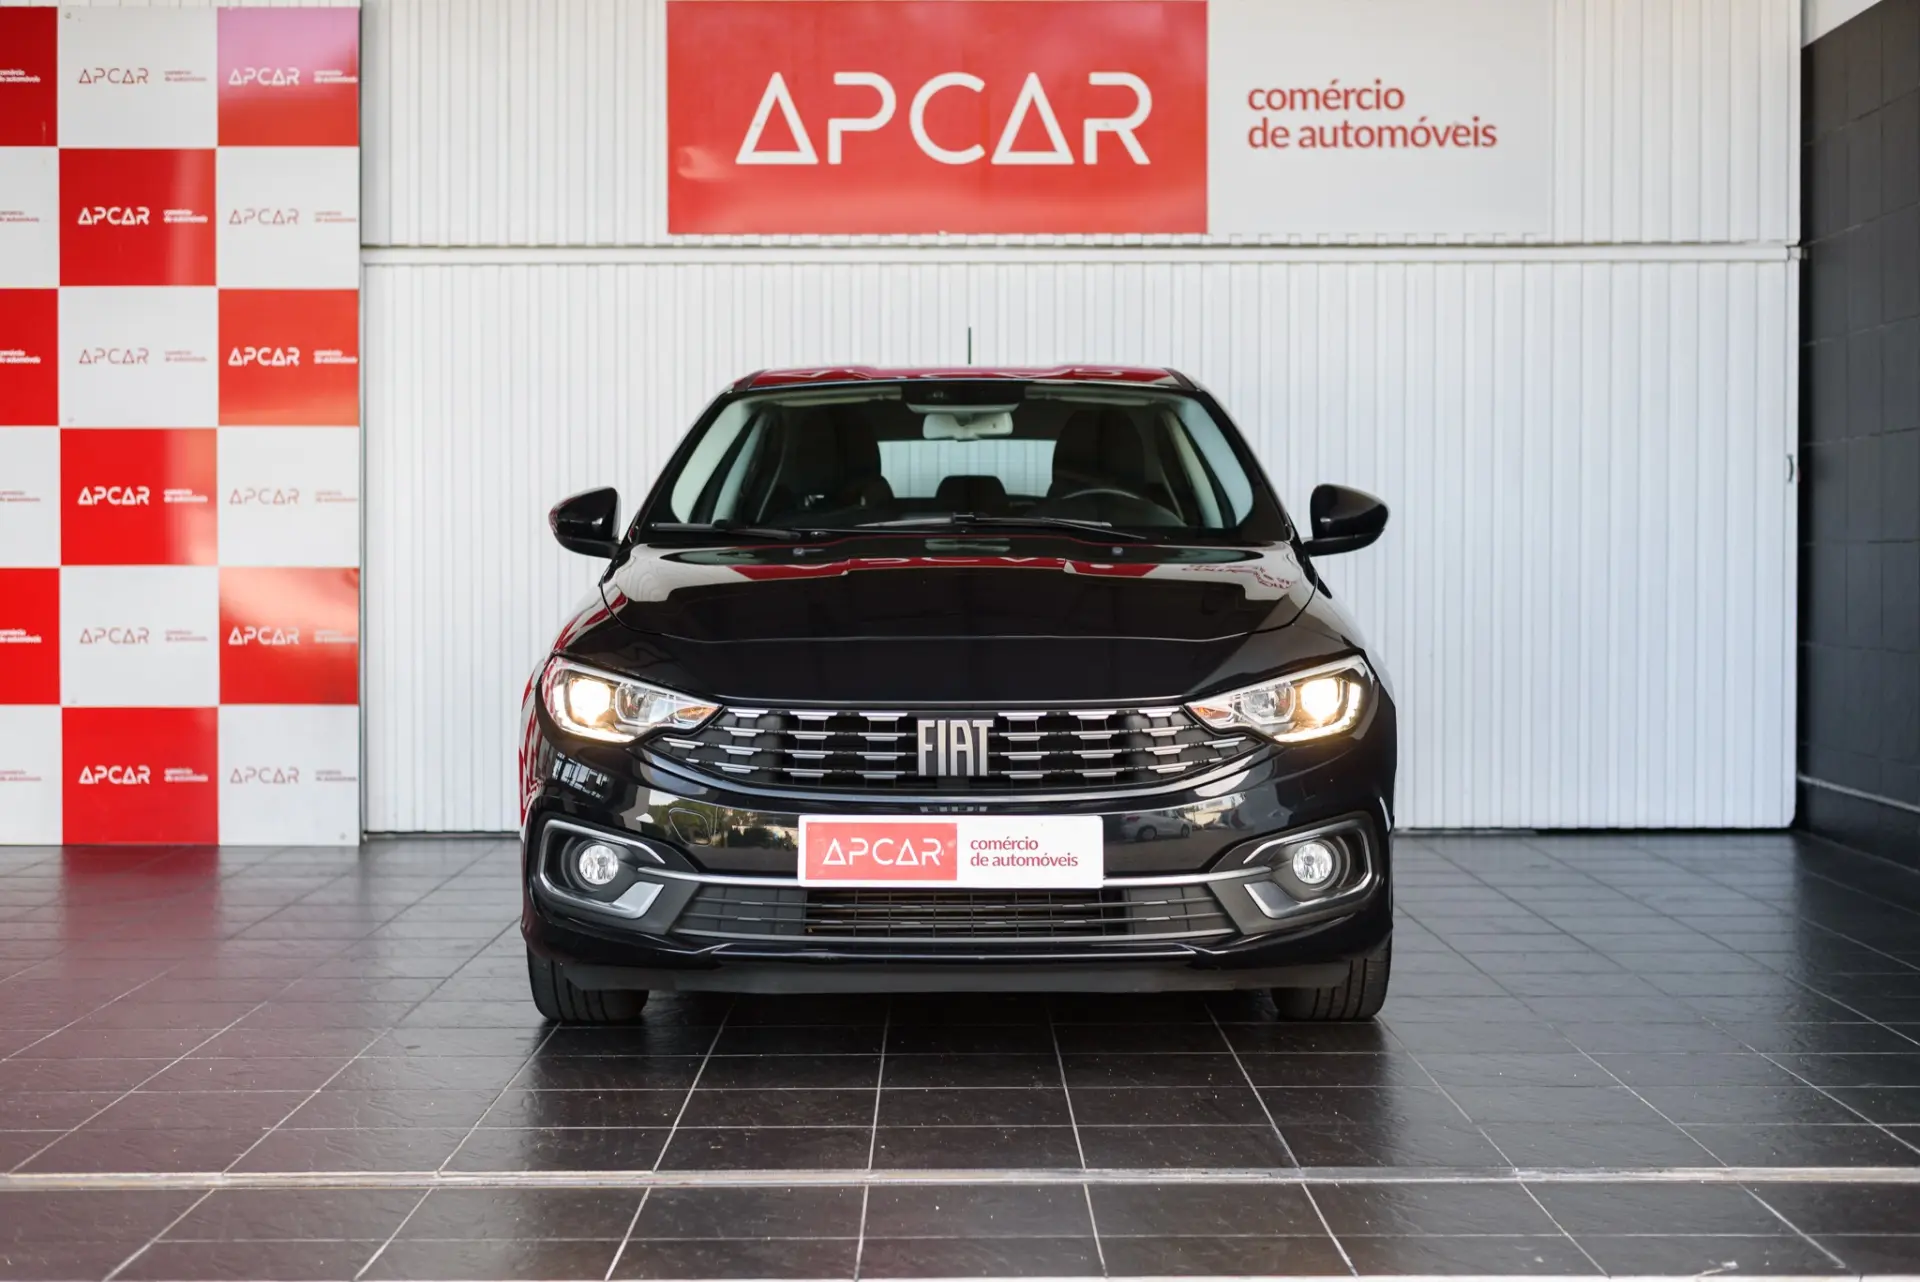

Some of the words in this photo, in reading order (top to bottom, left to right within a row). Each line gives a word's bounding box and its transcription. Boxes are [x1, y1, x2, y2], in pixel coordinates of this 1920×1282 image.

[78, 67, 149, 84] APCAR
[228, 67, 300, 86] APCAR
[1248, 79, 1406, 111] comércio
[736, 72, 1152, 164] APCAR
[1248, 117, 1290, 149] de
[1299, 116, 1498, 149] automóveis
[78, 206, 150, 225] APCAR
[228, 208, 299, 225] APCAR
[78, 347, 149, 365] APCAR
[228, 347, 300, 366] APCAR
[77, 486, 150, 505] APCAR
[228, 487, 299, 505] APCAR
[79, 627, 149, 645] APCAR
[228, 626, 299, 645] APCAR
[917, 719, 994, 776] FIAT
[78, 765, 151, 785] APCAR
[229, 766, 299, 784] APCAR
[822, 837, 943, 866] APCAR
[970, 835, 1039, 851] comércio
[970, 852, 989, 867] de
[993, 852, 1079, 867] automóveis
